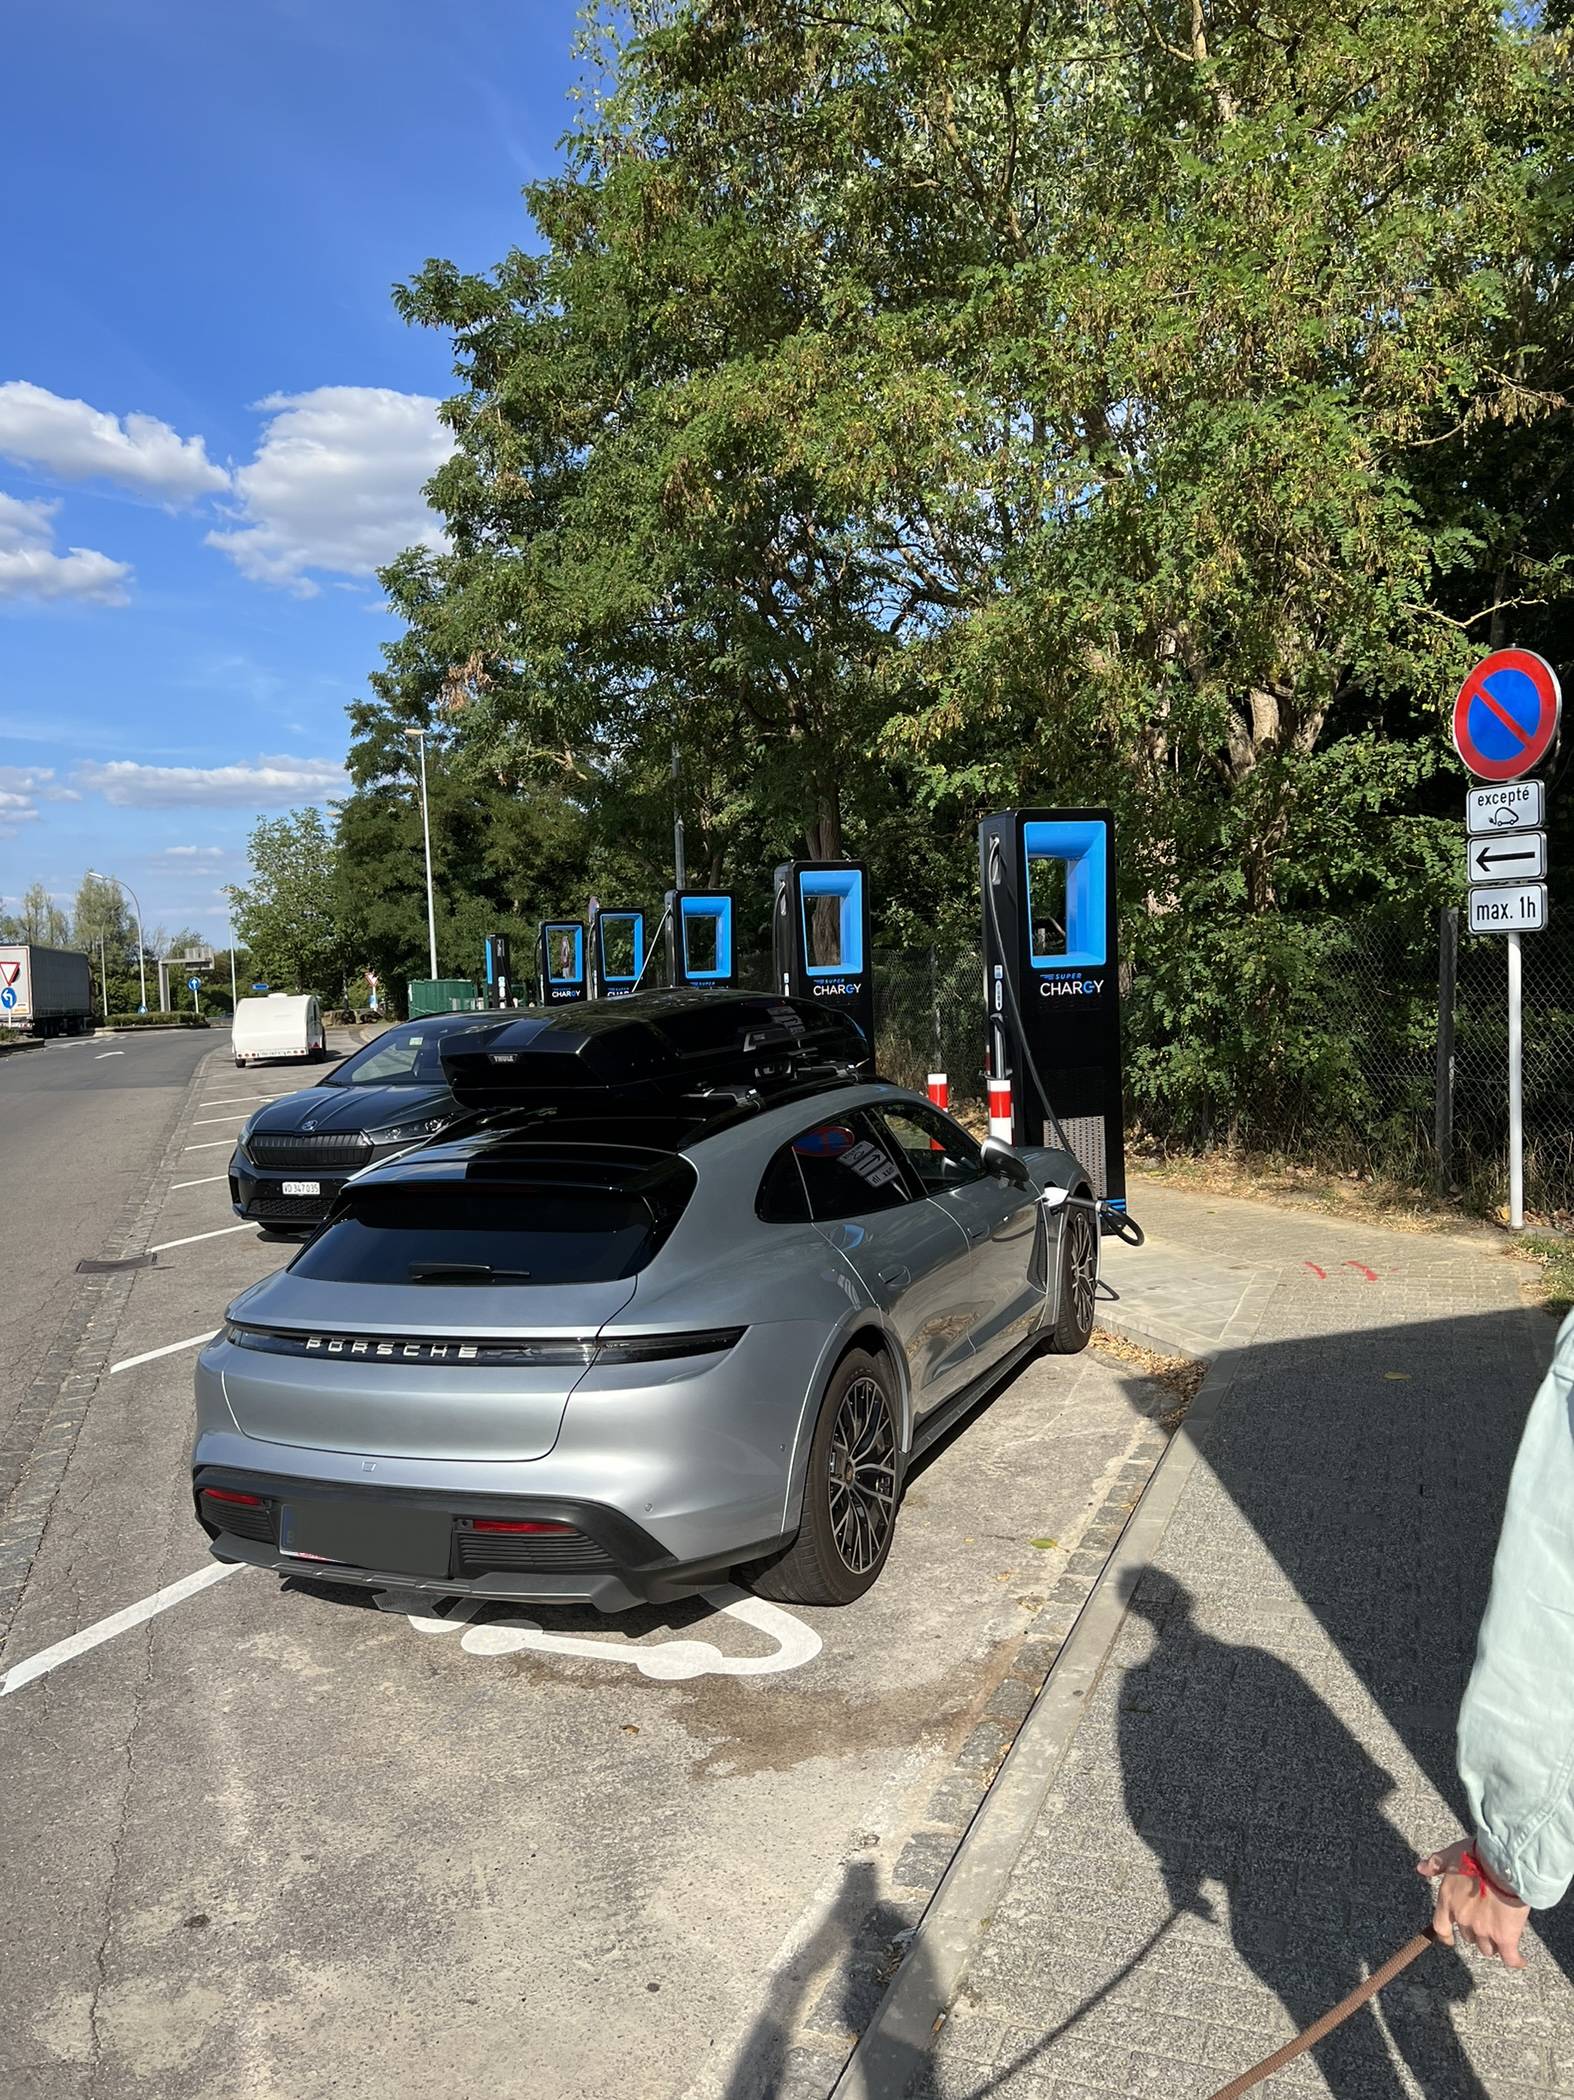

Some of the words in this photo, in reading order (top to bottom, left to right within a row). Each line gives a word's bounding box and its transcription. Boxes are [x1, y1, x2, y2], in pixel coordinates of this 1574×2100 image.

[1478, 785, 1530, 806] excepté
[1477, 903, 1513, 920] max.
[1520, 896, 1536, 918] 1h
[813, 983, 862, 996] CHARGY
[1040, 979, 1104, 997] CHARGY
[305, 1337, 478, 1358] PORSCHE
